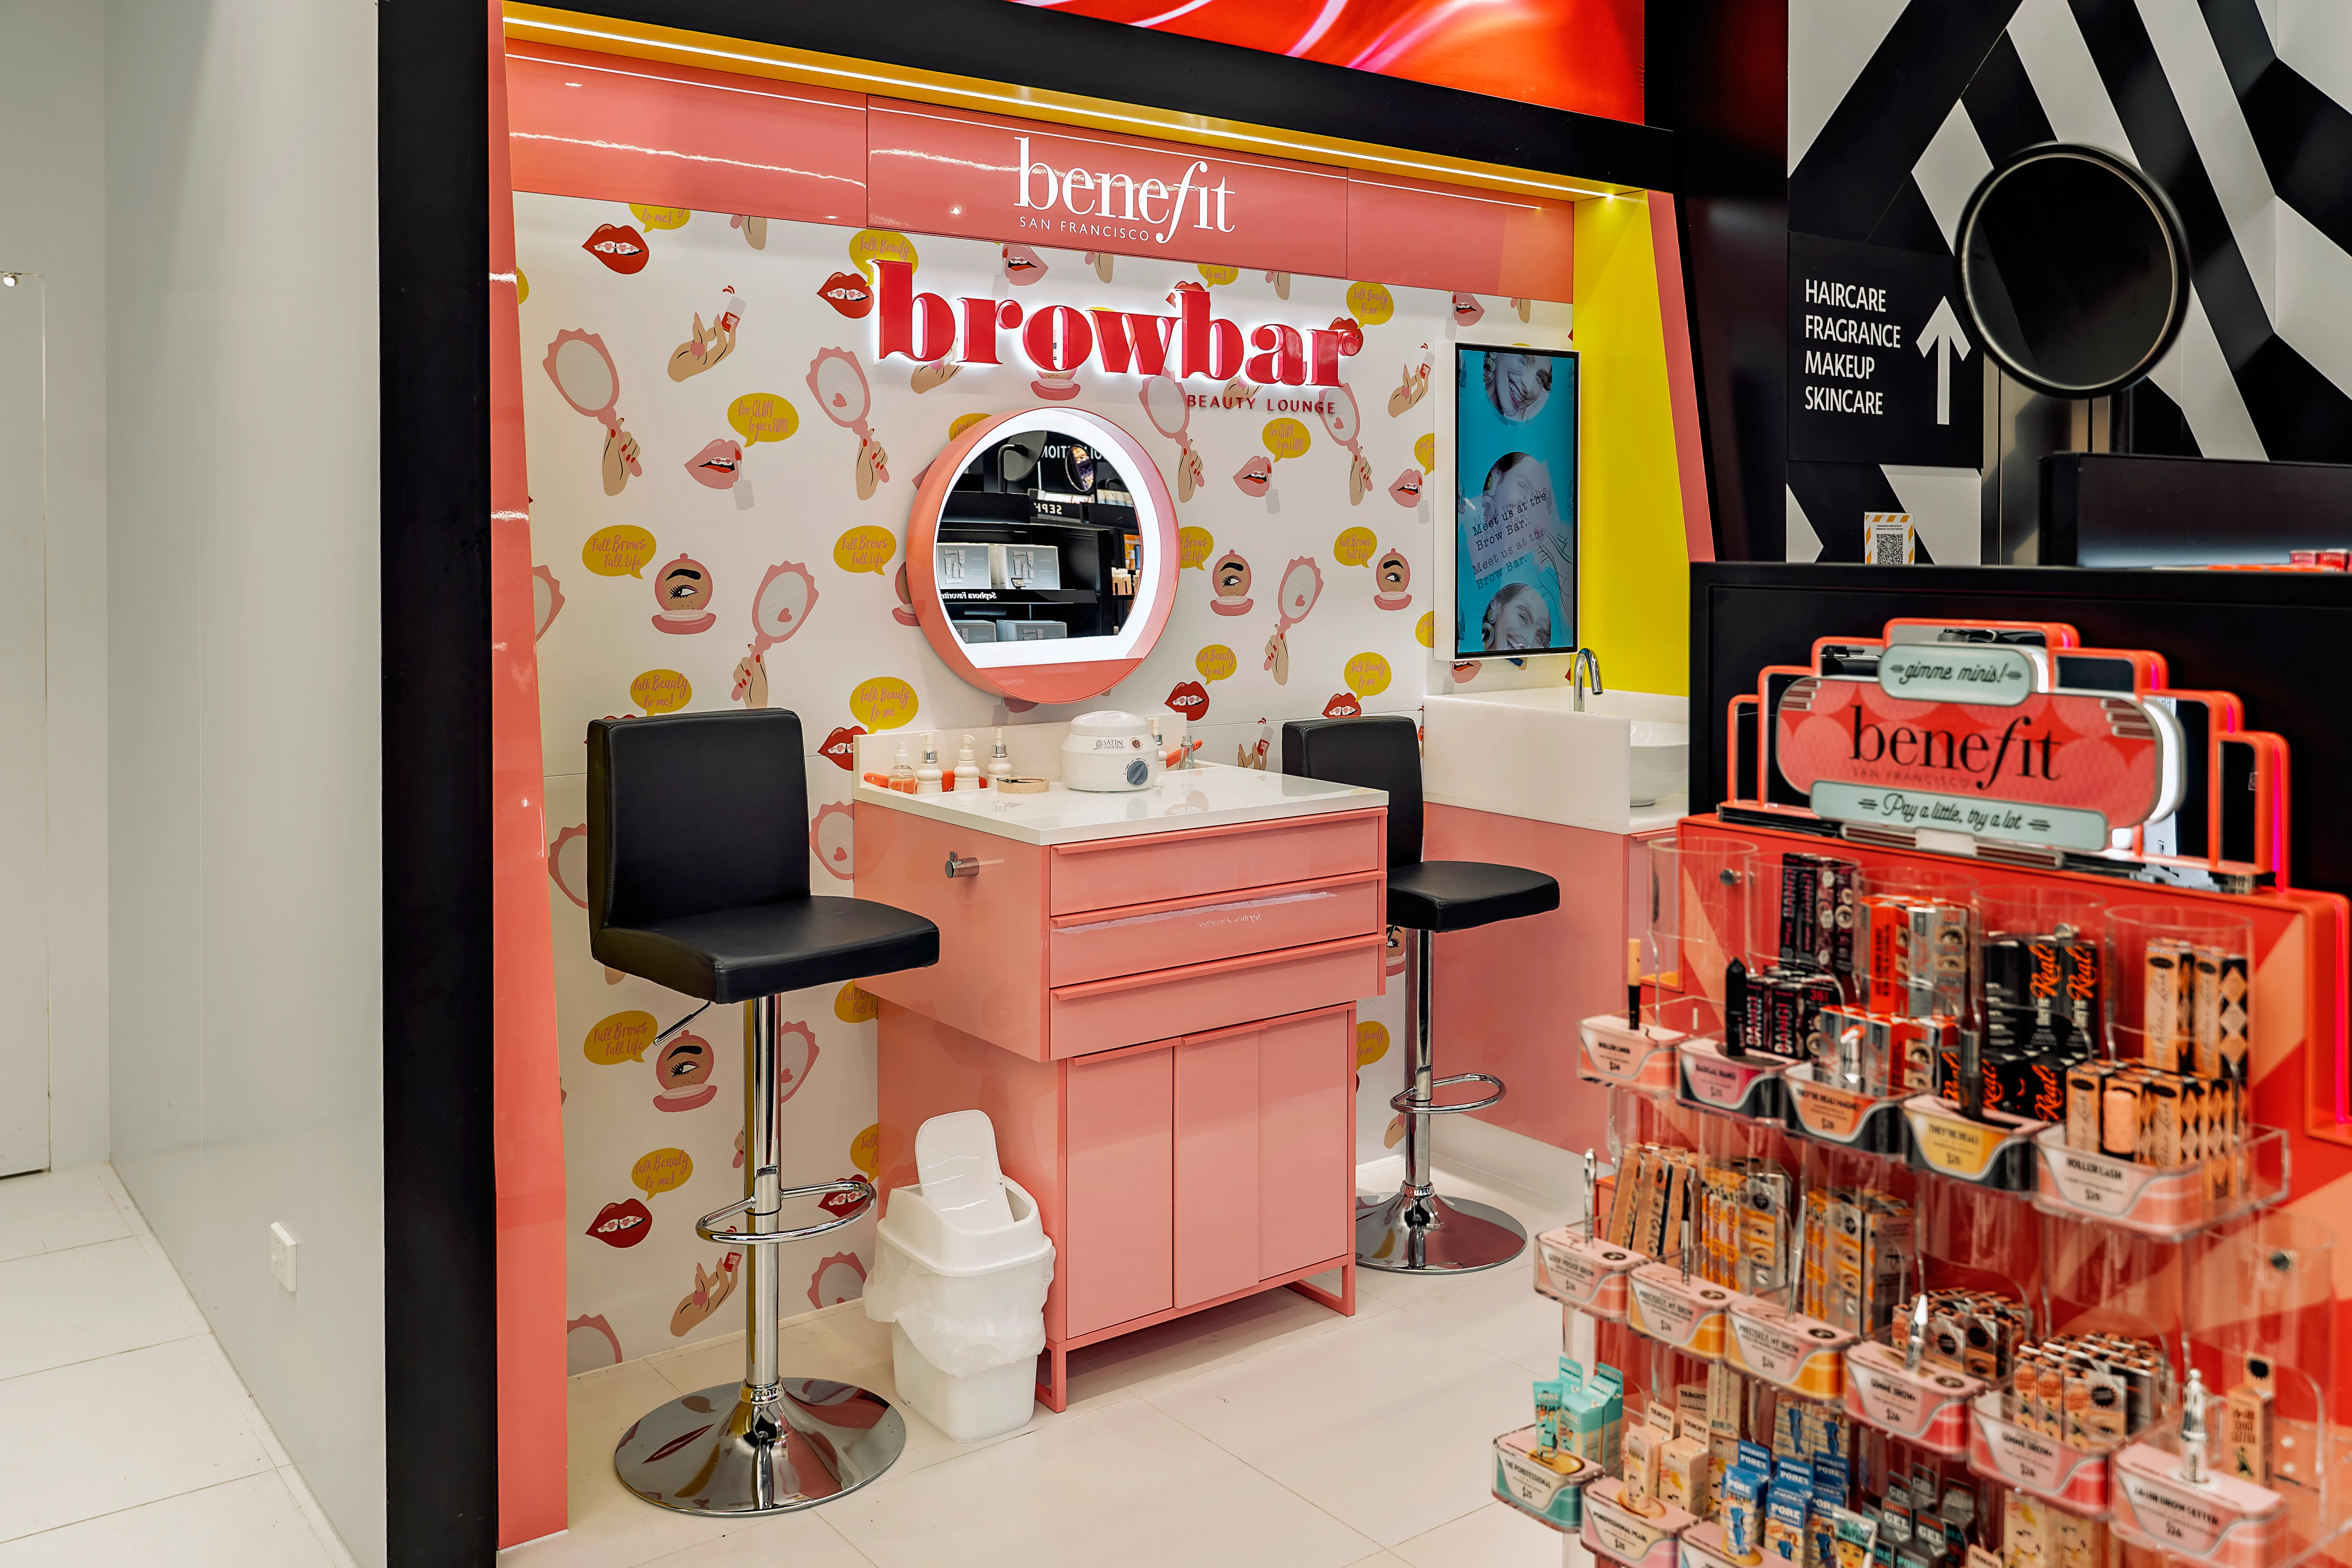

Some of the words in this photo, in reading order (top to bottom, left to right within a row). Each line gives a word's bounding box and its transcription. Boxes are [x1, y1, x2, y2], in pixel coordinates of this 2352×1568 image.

[1013, 136, 1236, 244] benefit
[642, 208, 652, 221] to
[655, 211, 672, 225] me!
[1020, 216, 1050, 230] SAN
[1061, 221, 1149, 241] FRANCISCO
[860, 236, 878, 251] Talk
[880, 239, 911, 262] Beauty
[1354, 287, 1366, 299] Talk
[1367, 289, 1388, 310] Beauty
[1805, 279, 1886, 312] HAIRCARE
[1360, 302, 1368, 317] to
[871, 260, 1361, 388] browbar
[1805, 314, 1901, 348] FRAGRANCE
[1805, 350, 1875, 379] MAKEUP
[739, 399, 751, 416] too
[1187, 394, 1256, 409] BEAUTY
[1267, 398, 1336, 413] LOUNGE
[1805, 386, 1883, 415] SKINCARE
[749, 417, 755, 432] to
[754, 420, 767, 441] give
[768, 424, 772, 433] a
[1269, 423, 1278, 437] too
[1276, 437, 1281, 450] to
[1472, 516, 1499, 537] Meet
[1501, 509, 1514, 521] us
[1517, 501, 1528, 514] at
[1530, 492, 1547, 507] the
[592, 537, 611, 552] Full
[612, 534, 647, 553] Brows
[842, 537, 858, 550] Full
[859, 534, 888, 551] Brows
[1184, 534, 1207, 549] Brows
[1339, 536, 1351, 548] Full
[1351, 534, 1372, 548] Brows
[1475, 531, 1503, 552] Brow
[852, 552, 868, 566] Full
[869, 552, 885, 568] Life
[1192, 550, 1205, 564] Life
[1346, 549, 1358, 560] Full
[1358, 548, 1369, 562] Life
[1472, 553, 1499, 576] Meet
[1501, 546, 1514, 559] us
[1516, 538, 1527, 550] at
[1529, 528, 1546, 542] the
[604, 553, 623, 568] Full
[625, 554, 642, 571] Life
[1475, 568, 1503, 590] Brow
[1210, 648, 1235, 669] Beauty
[1204, 664, 1212, 676] to
[1213, 664, 1225, 676] me!
[1351, 660, 1364, 674] Talk
[1365, 659, 1387, 680] Beauty
[1898, 661, 1953, 684] gimme
[1957, 662, 2008, 683] minis!
[652, 673, 688, 699] Beauty
[1358, 674, 1367, 690] to
[1367, 676, 1376, 687] me
[644, 693, 654, 708] to
[656, 693, 673, 707] me!
[860, 686, 878, 702] Talk
[880, 684, 911, 709] Beauty
[870, 703, 882, 722] to
[883, 706, 896, 718] me
[1848, 704, 2063, 790] benefit
[1852, 768, 1880, 779] SAN
[1886, 769, 1970, 789] FRANCISCO
[1881, 792, 1919, 823] Pay
[1919, 805, 1929, 818] a
[1931, 801, 1962, 823] little,
[1967, 808, 1987, 831] try
[1990, 813, 2001, 826] a
[2002, 810, 2023, 830] lot
[843, 988, 858, 1002] Full
[853, 1001, 869, 1016] Full
[593, 1027, 613, 1043] Full
[613, 1022, 648, 1041] Brows
[1363, 1026, 1385, 1047] Beauty
[606, 1041, 624, 1057] Full
[626, 1038, 644, 1056] Life
[1357, 1044, 1364, 1060] to
[653, 1150, 690, 1176] Beauty
[645, 1175, 656, 1190] to
[657, 1171, 675, 1186] me!
[1740, 1445, 1767, 1459] HYDRATE
[1740, 1455, 1766, 1470] PORES
[1505, 1459, 1514, 1469] THE
[1514, 1463, 1552, 1489] POREFESSIONAL
[1780, 1470, 1809, 1485] PORES
[1522, 1486, 1533, 1499] $25
[1727, 1479, 1750, 1492] PORE
[1770, 1503, 1800, 1520] PORE
[1593, 1510, 1630, 1534] POREFESSIONAL
